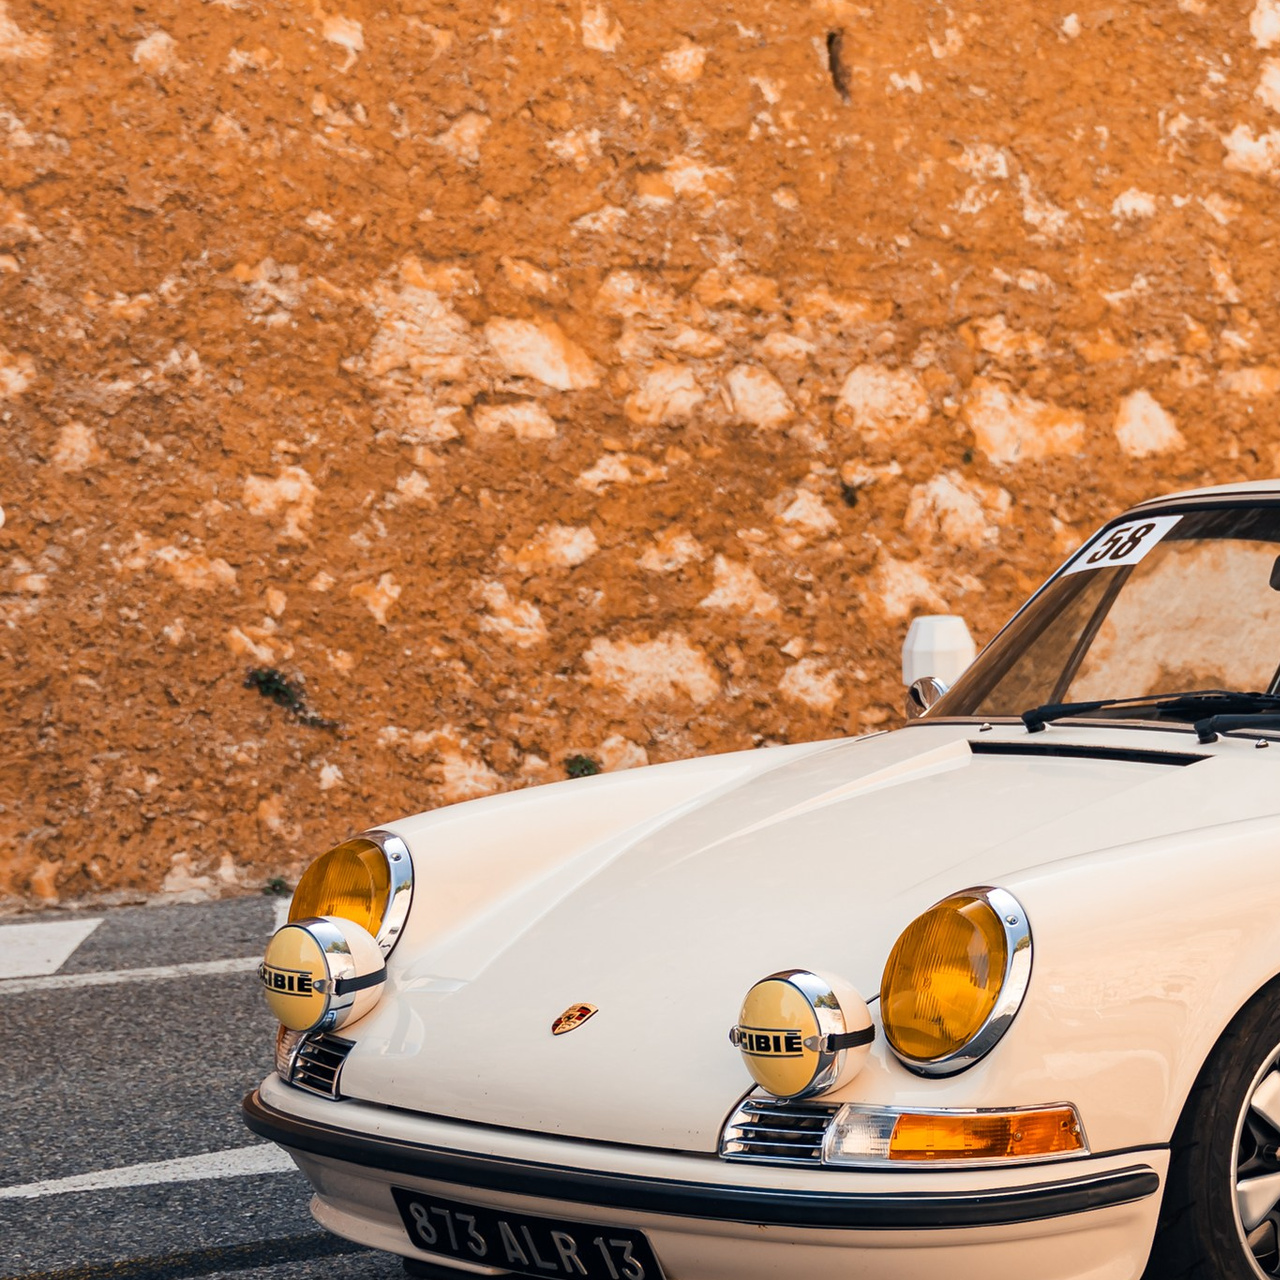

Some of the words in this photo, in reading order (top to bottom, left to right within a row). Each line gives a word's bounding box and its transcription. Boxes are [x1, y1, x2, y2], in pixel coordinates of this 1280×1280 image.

[1085, 522, 1157, 565] 58
[408, 1201, 488, 1258] 873
[497, 1220, 589, 1276] ALR
